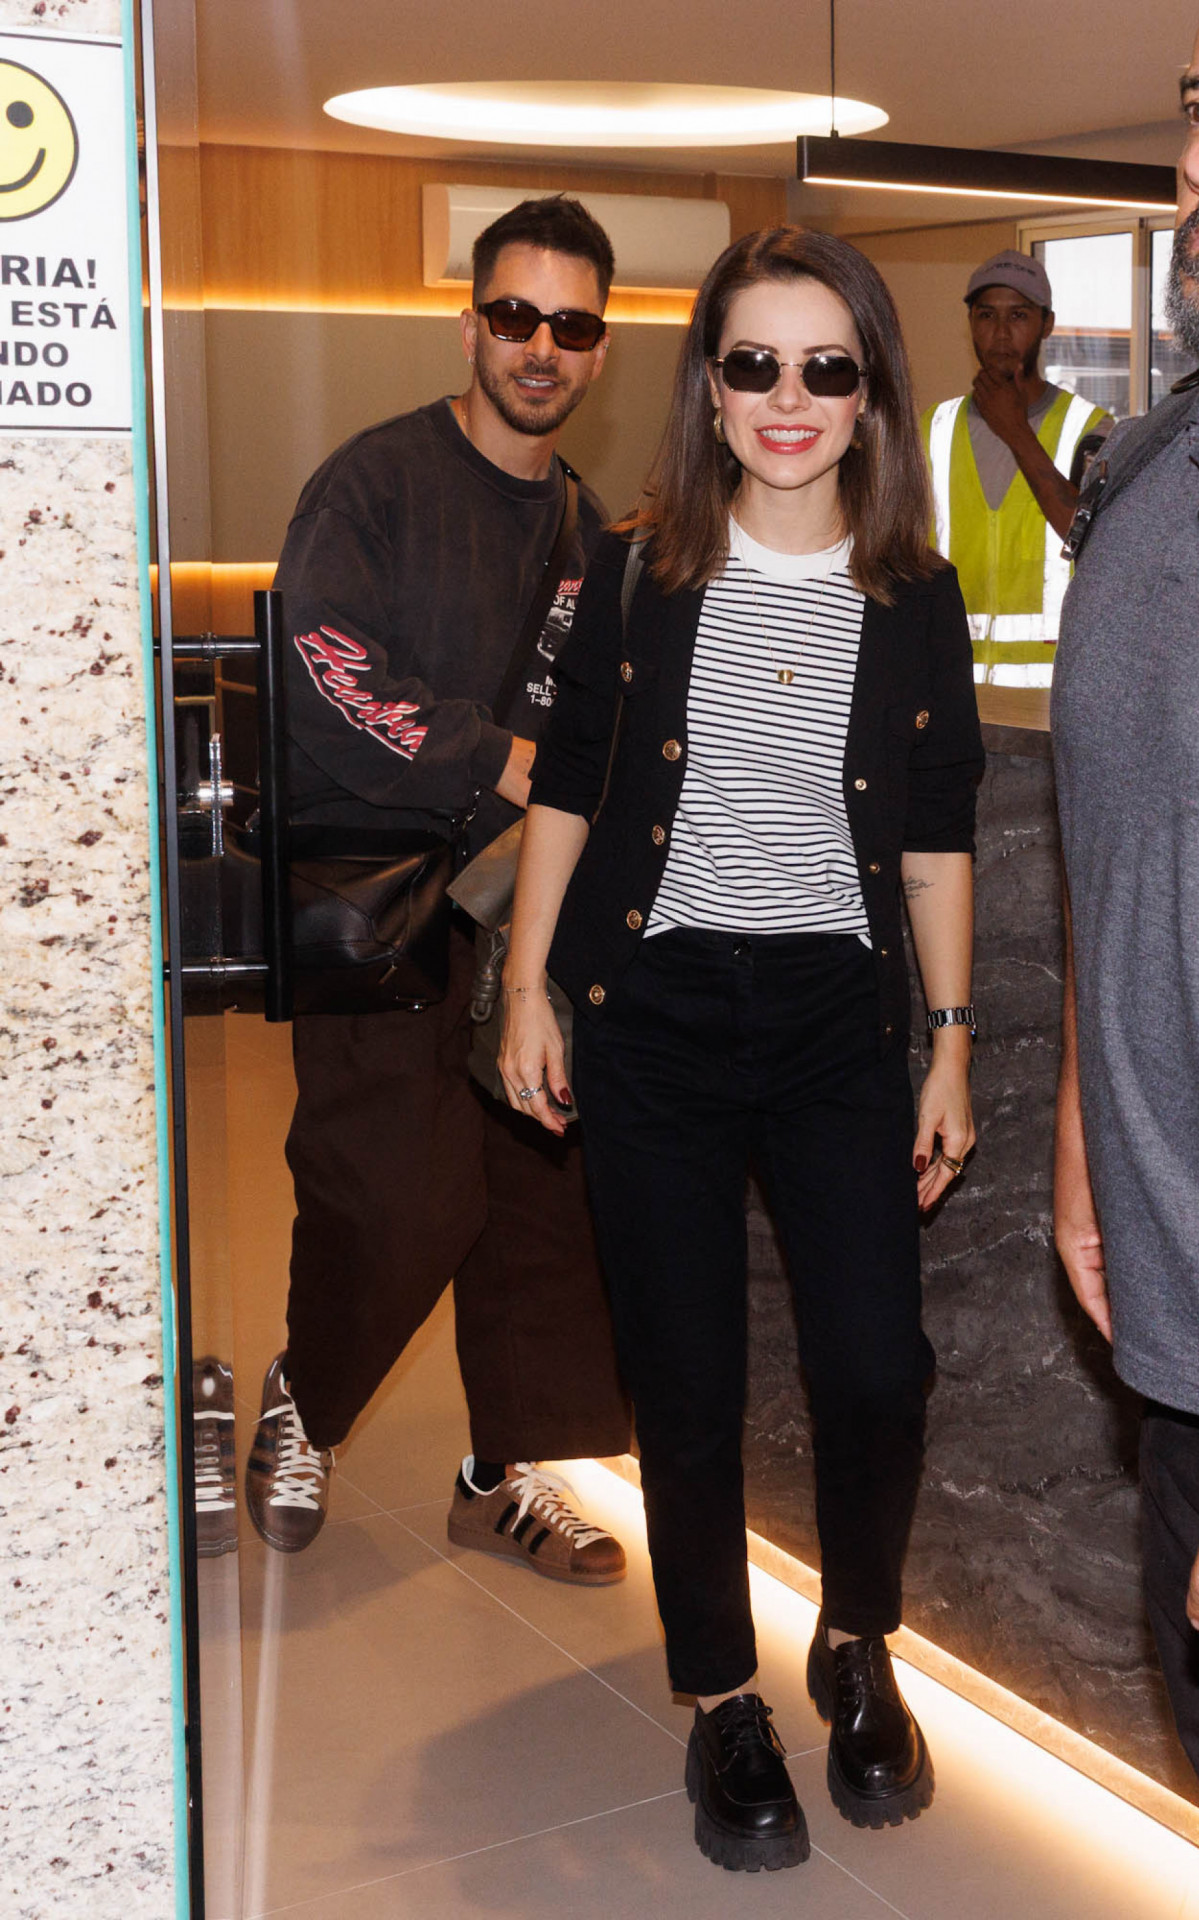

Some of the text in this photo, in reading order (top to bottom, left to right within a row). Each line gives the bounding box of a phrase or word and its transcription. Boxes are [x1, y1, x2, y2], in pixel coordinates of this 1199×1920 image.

[0, 254, 97, 289] RIA!
[11, 298, 117, 330] ESTÁ
[0, 380, 92, 407] ADO
[526, 682, 551, 696] SELL
